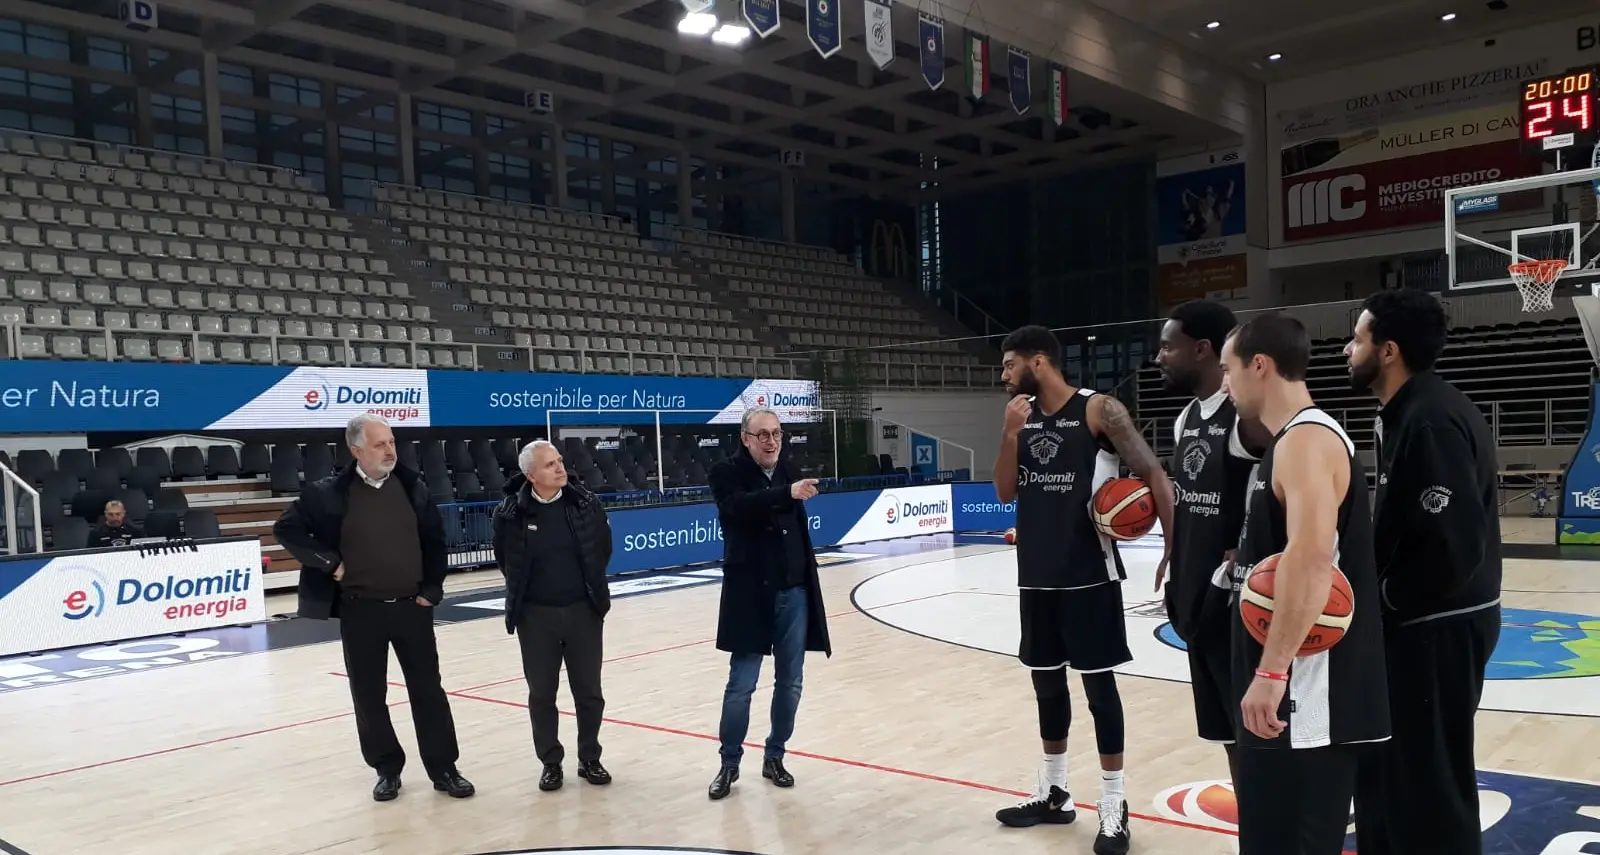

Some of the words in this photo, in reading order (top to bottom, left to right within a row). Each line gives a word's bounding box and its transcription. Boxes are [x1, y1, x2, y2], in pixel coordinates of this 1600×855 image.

[135, 2, 152, 20] D
[1345, 93, 1381, 112] ORA
[1384, 81, 1447, 104] ANCHE
[1525, 73, 1591, 100] 20:00
[540, 93, 550, 107] E
[1462, 122, 1480, 137] DI
[1528, 95, 1590, 139] 24
[1378, 168, 1502, 196] MEDIOCREDITO
[50, 380, 160, 407] Natura
[336, 386, 422, 404] Dolomiti
[489, 387, 592, 408] sostenibile
[598, 394, 628, 414] per
[633, 389, 686, 408] Natura
[1030, 472, 1077, 483] Dolomiti
[1043, 484, 1073, 493] energia
[903, 499, 949, 518] Dolomiti
[918, 515, 947, 528] energia
[624, 518, 724, 552] sostenibile
[116, 567, 252, 606] Dolomiti
[163, 595, 247, 620] energia
[0, 651, 243, 691] RENA
